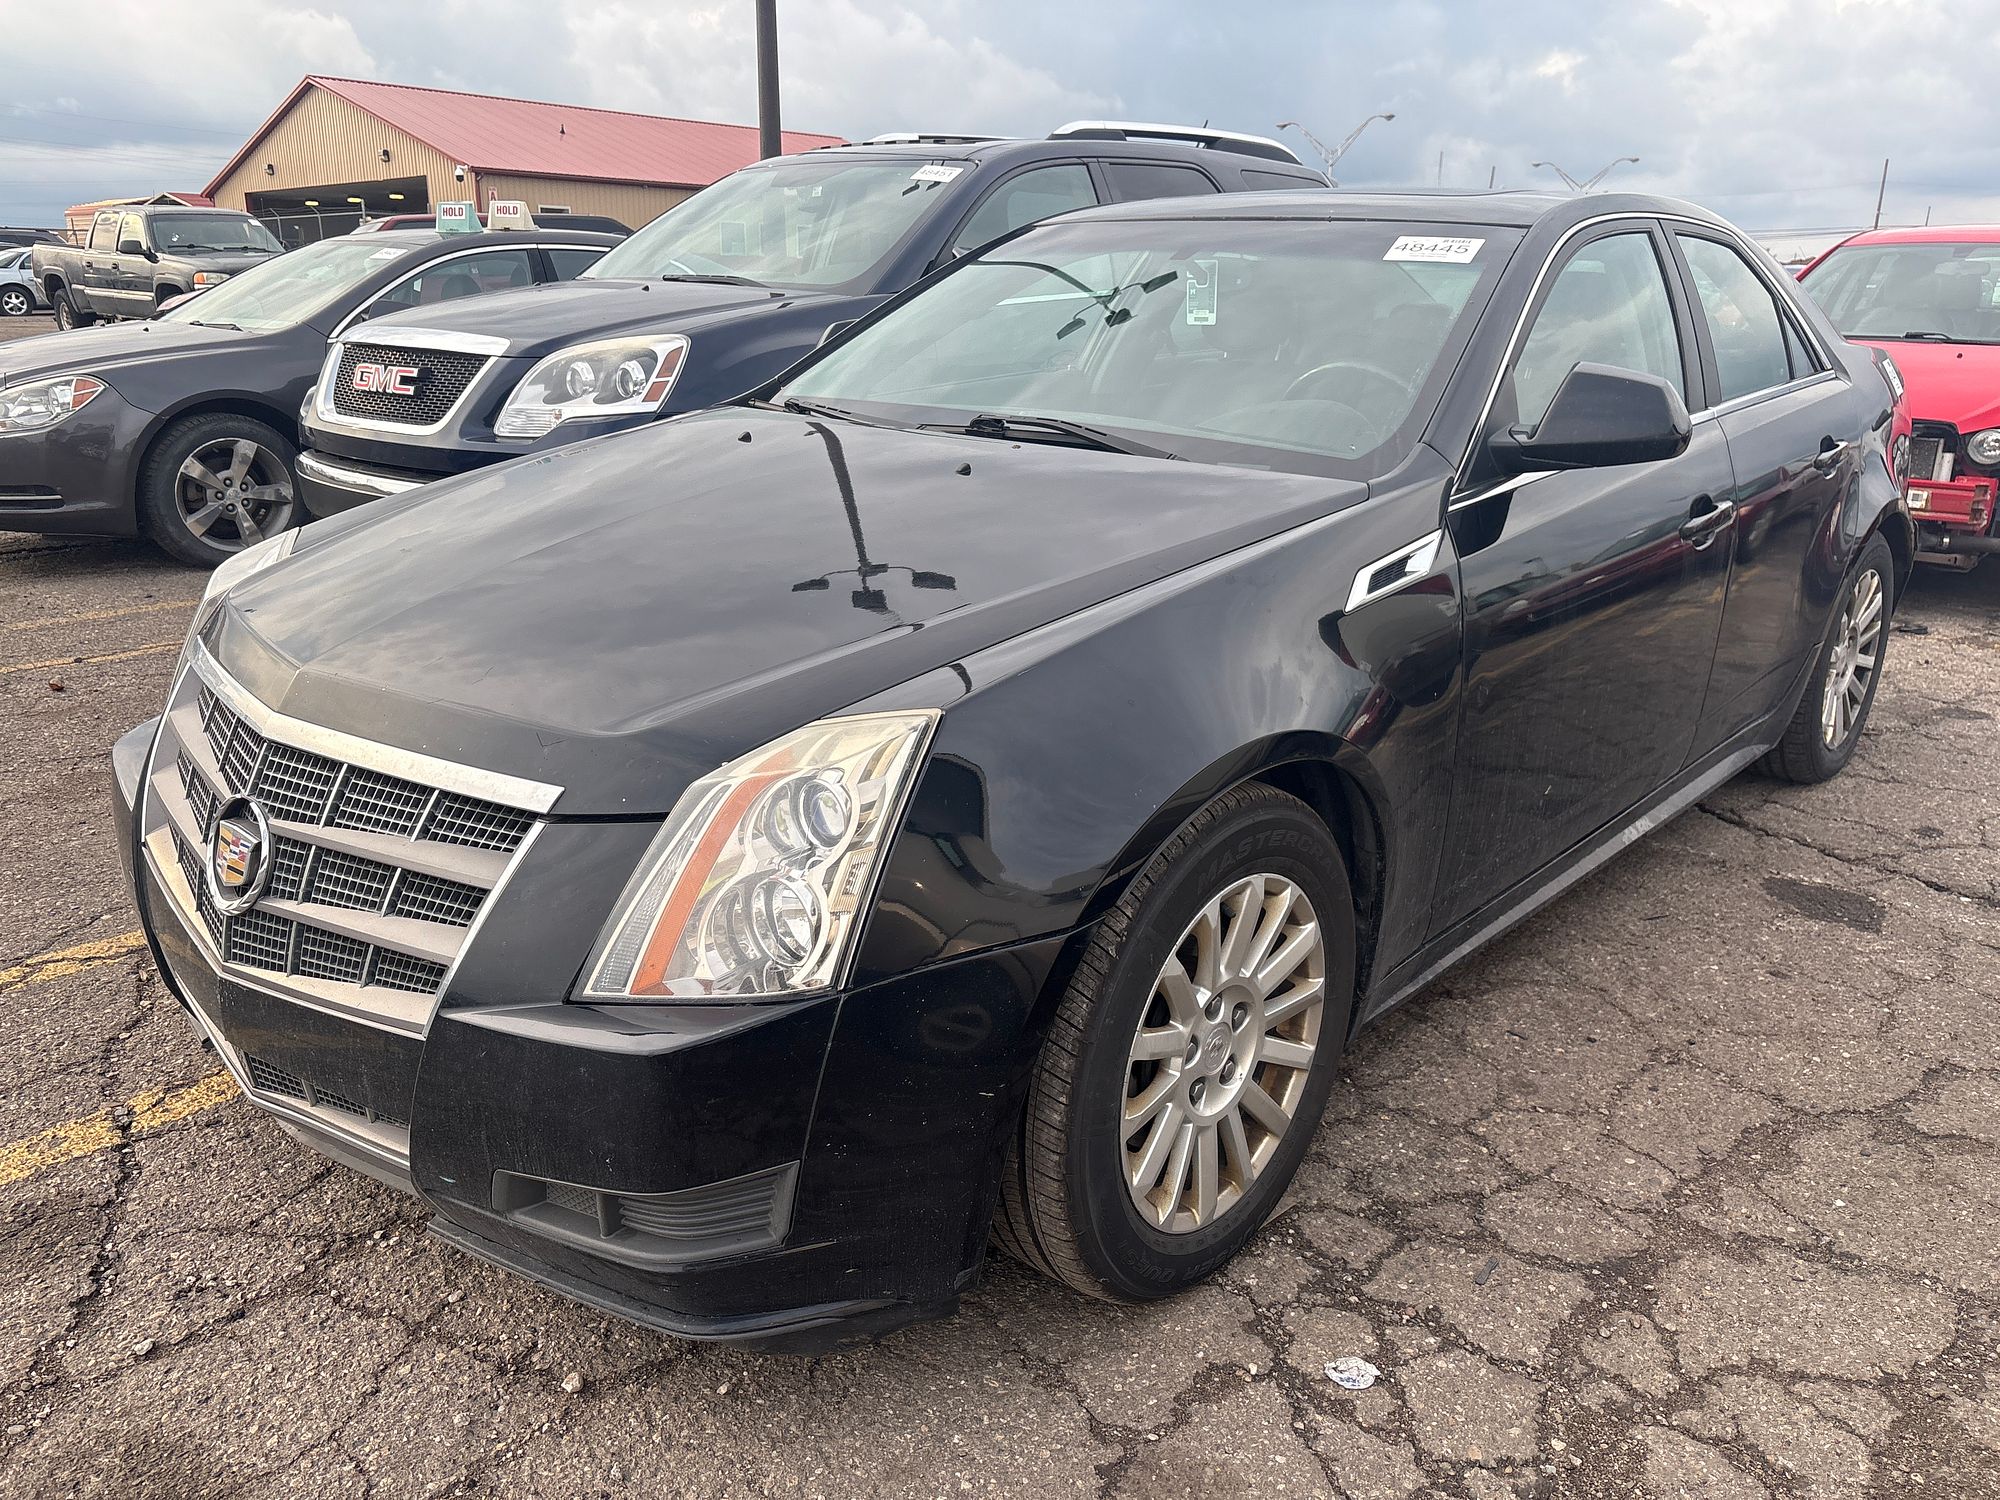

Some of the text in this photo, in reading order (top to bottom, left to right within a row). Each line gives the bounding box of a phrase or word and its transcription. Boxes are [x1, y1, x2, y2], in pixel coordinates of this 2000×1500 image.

[442, 207, 464, 217] HOLD
[496, 205, 518, 215] HOLD
[1394, 242, 1470, 254] 48445
[353, 363, 418, 395] GMC
[1197, 828, 1345, 896] MASTERCRA
